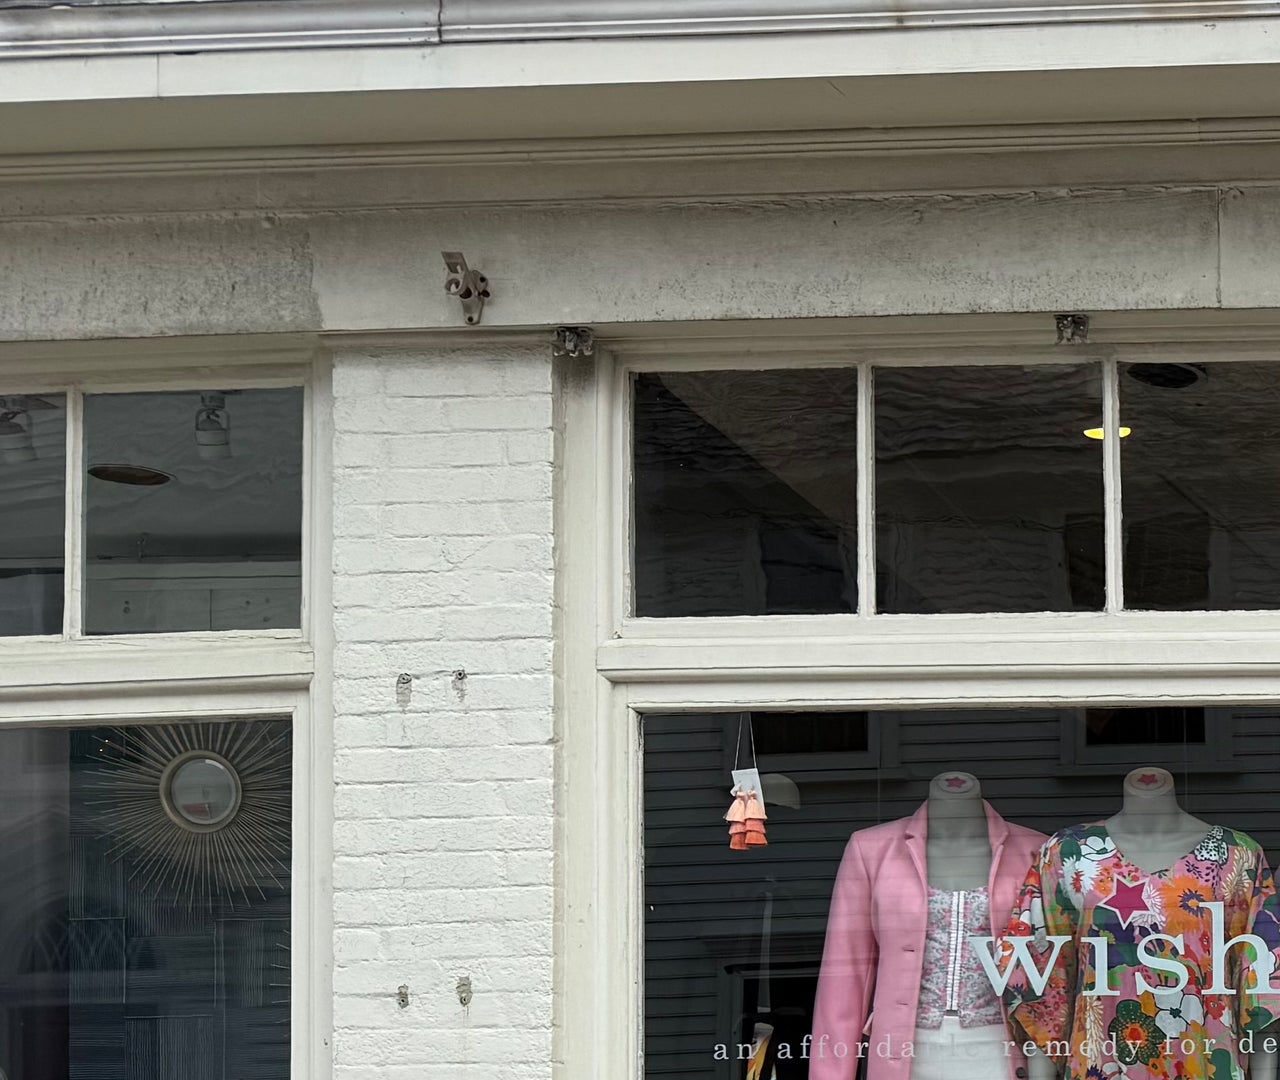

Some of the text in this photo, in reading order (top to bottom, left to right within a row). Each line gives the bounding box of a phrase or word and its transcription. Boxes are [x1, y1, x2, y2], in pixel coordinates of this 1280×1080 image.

[713, 1041, 757, 1060] an
[1002, 1031, 1140, 1061] remedy
[1164, 1034, 1217, 1056] for
